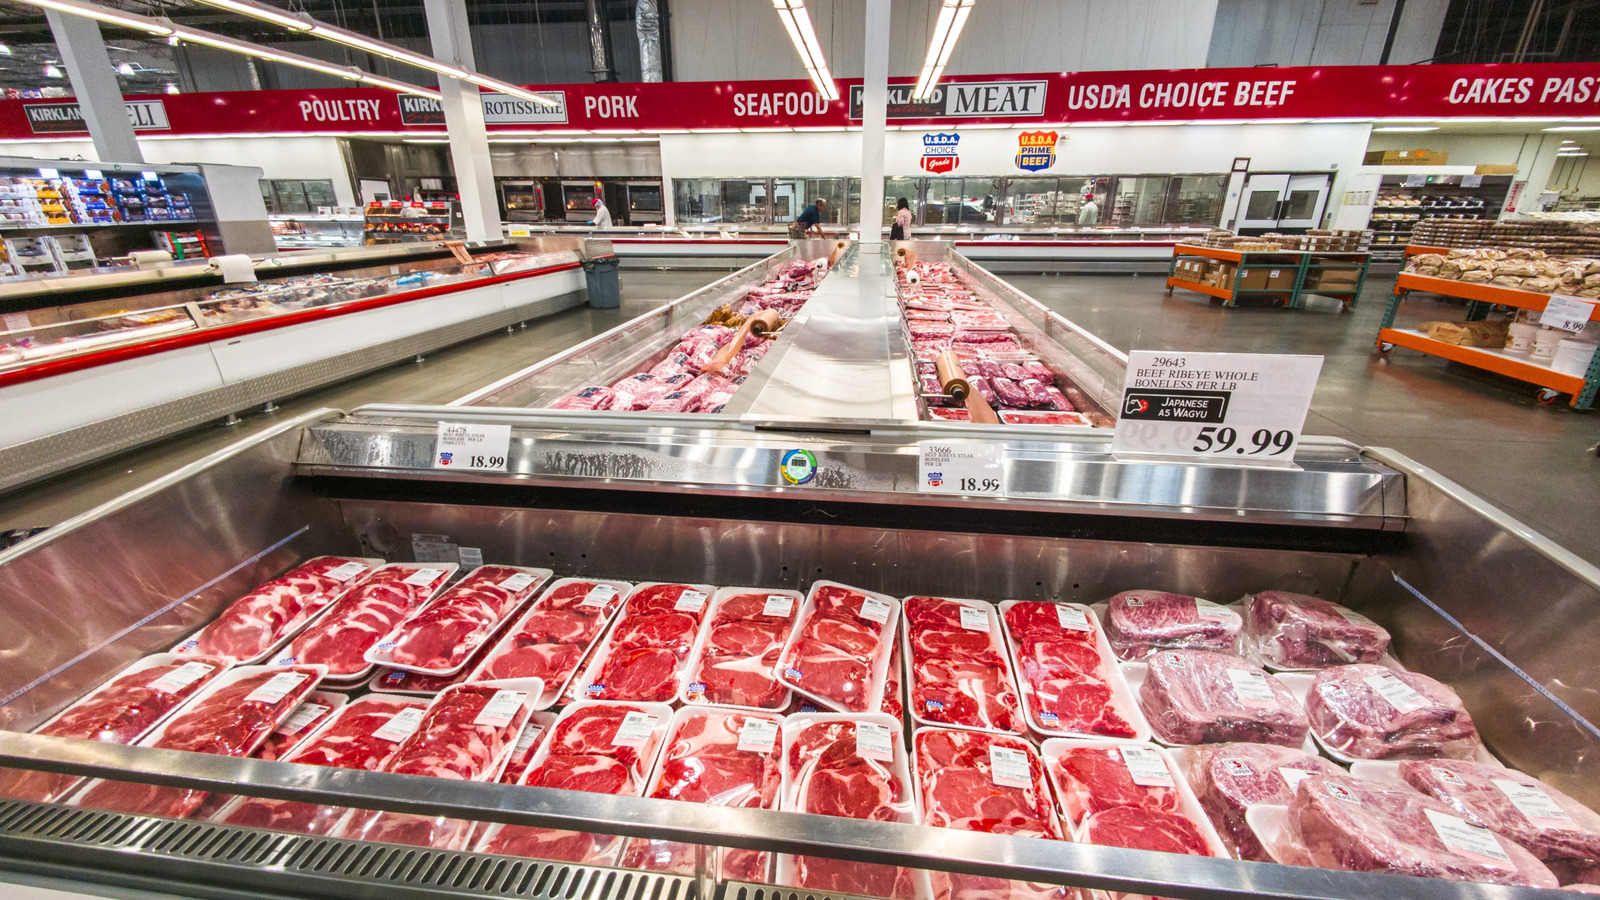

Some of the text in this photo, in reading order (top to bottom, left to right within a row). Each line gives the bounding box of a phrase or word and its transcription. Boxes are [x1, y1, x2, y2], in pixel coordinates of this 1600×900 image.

[1068, 80, 1297, 110] USDA CHOICE BEEF
[1449, 77, 1533, 104] CAKES
[733, 92, 829, 117] SEAFOOD
[954, 85, 1037, 113] MEAT
[300, 99, 380, 122] POULTRY
[584, 95, 640, 119] PORK
[30, 107, 85, 121] KIRKLAN
[925, 135, 958, 144] U.S.D.A.
[1021, 135, 1055, 145] U.S.D.A.
[925, 146, 956, 154] CHOICE
[928, 158, 951, 170] Grade
[1022, 156, 1049, 166] BEEF
[1562, 320, 1584, 332] 8.99
[1151, 357, 1187, 368] 29643
[1136, 368, 1260, 382] BEEF RIBEYE WHOLE
[1134, 378, 1237, 391] BONELESS PER LB
[1161, 397, 1209, 409] JAPANESE
[1157, 409, 1171, 418] A5
[1192, 426, 1294, 457] 59.99
[470, 455, 505, 468] 18.99
[960, 477, 1001, 492] 18.99
